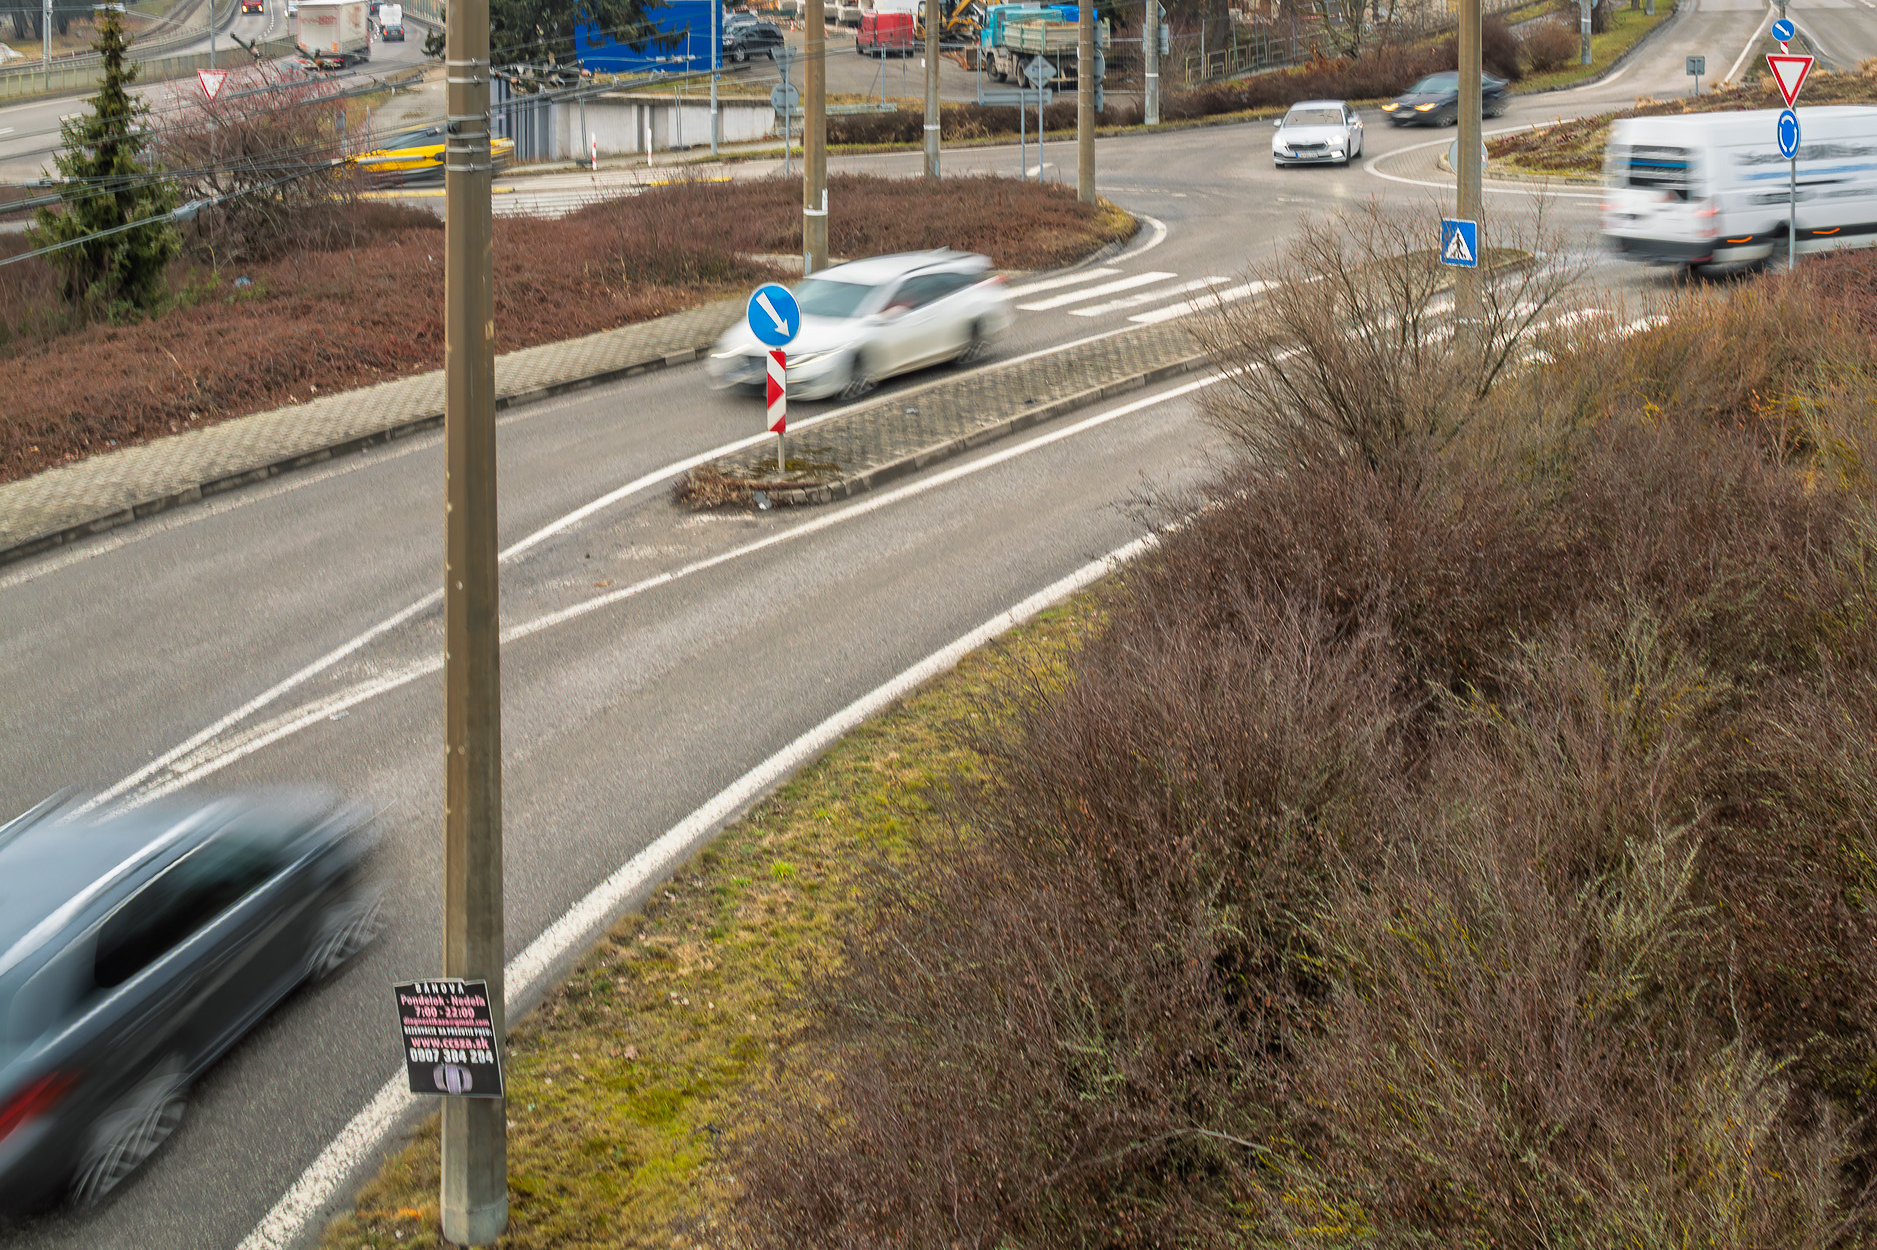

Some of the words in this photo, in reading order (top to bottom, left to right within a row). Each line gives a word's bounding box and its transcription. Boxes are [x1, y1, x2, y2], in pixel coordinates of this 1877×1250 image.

[400, 993, 445, 1006] Pondelok
[414, 1005, 438, 1018] 7:00
[444, 1006, 475, 1019] 22:00
